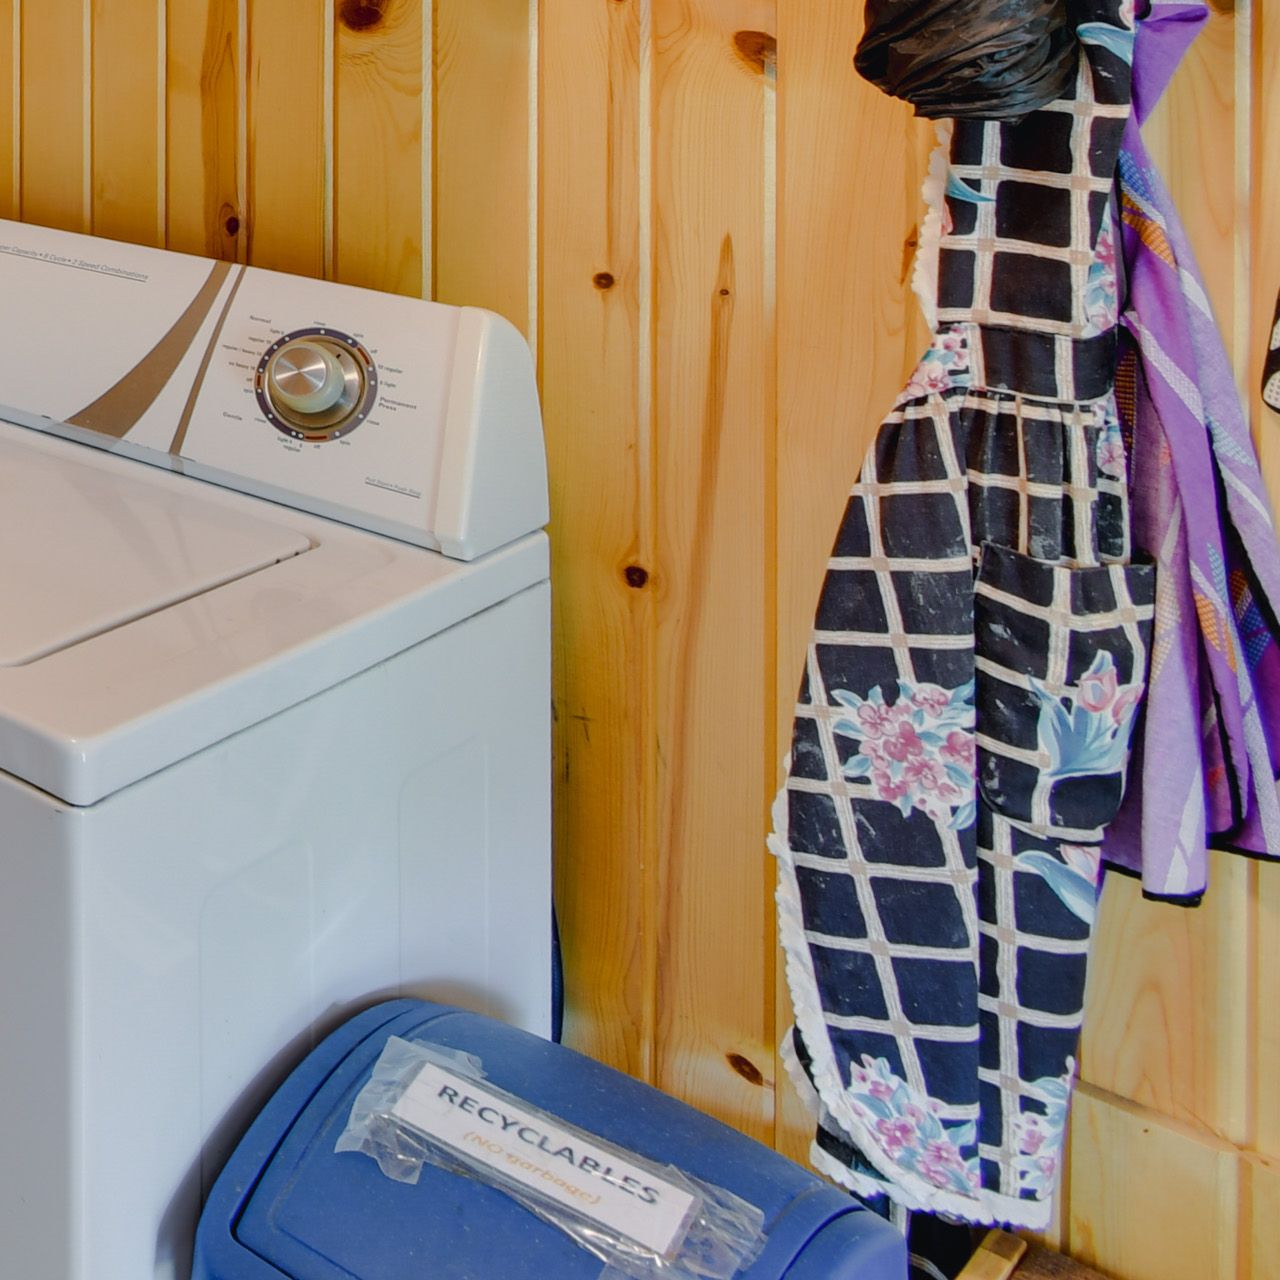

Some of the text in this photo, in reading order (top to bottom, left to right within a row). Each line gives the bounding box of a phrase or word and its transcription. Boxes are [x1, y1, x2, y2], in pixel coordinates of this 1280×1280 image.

[437, 1084, 661, 1206] RECYCLABLES
[463, 1131, 602, 1205] (NO garbage)
